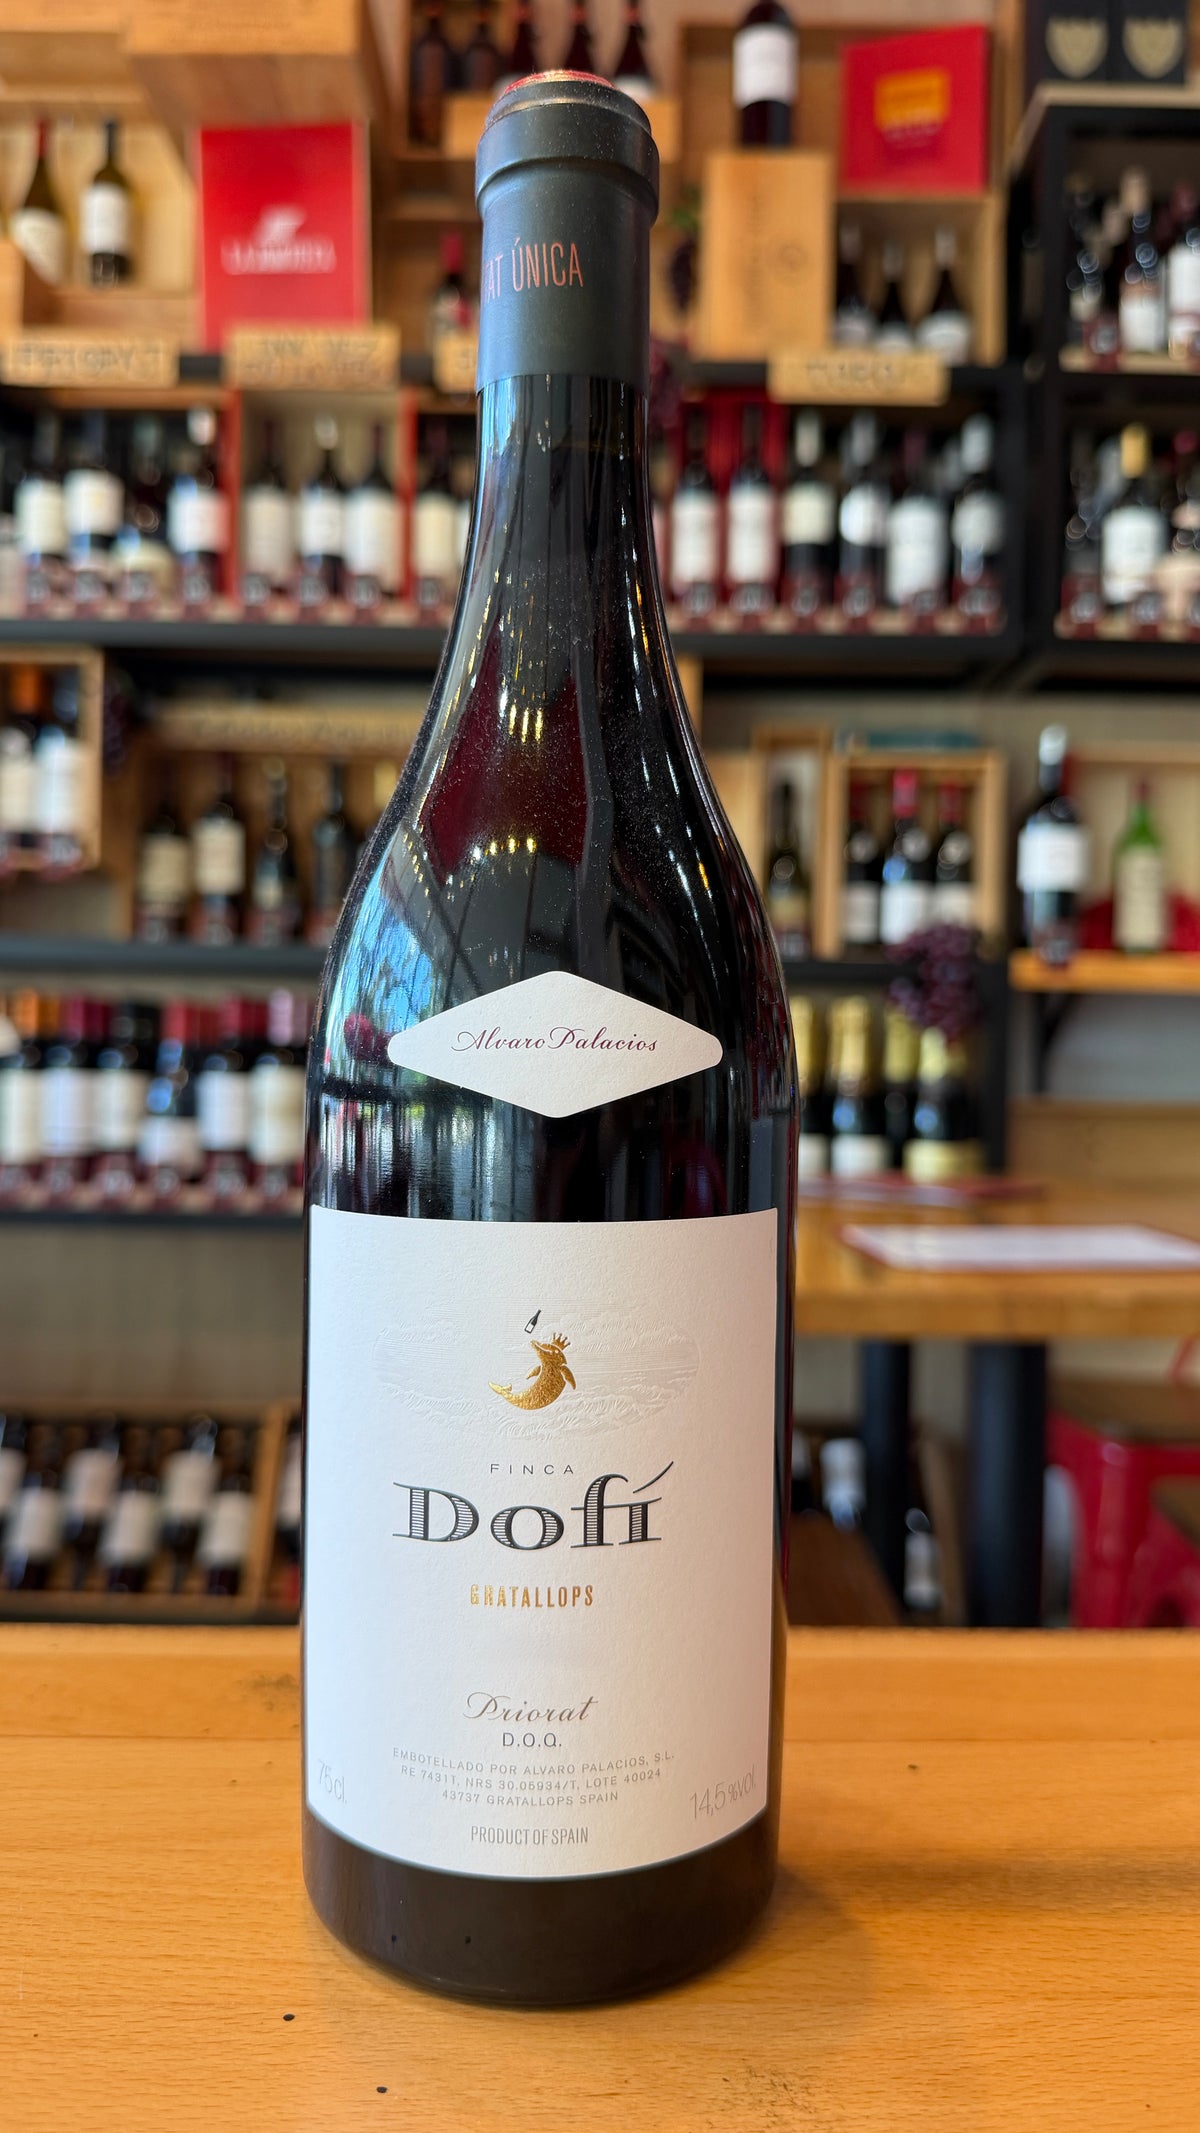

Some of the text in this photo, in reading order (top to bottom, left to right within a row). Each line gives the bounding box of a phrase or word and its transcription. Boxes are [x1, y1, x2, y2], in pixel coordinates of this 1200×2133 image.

[511, 237, 584, 292] ÚNICA
[451, 1026, 658, 1052] Alvaro Palacios
[490, 1463, 575, 1475] FINCA
[392, 1461, 674, 1551] Dofí
[470, 1584, 594, 1608] GRATALLOPS
[462, 1691, 599, 1722] Priorat
[502, 1732, 562, 1748] D.O.Q.
[392, 1747, 675, 1776] EMBOTELLADO POR ALVARO PALACIOS, S.L.
[401, 1764, 416, 1778] RE
[466, 1778, 492, 1789] NRS
[586, 1775, 618, 1789] LOTE
[624, 1768, 661, 1784] 40024
[442, 1789, 619, 1807] 43737 GRATALLOPS SPAIN
[471, 1825, 589, 1846] PRODUCT OF SPAIN
